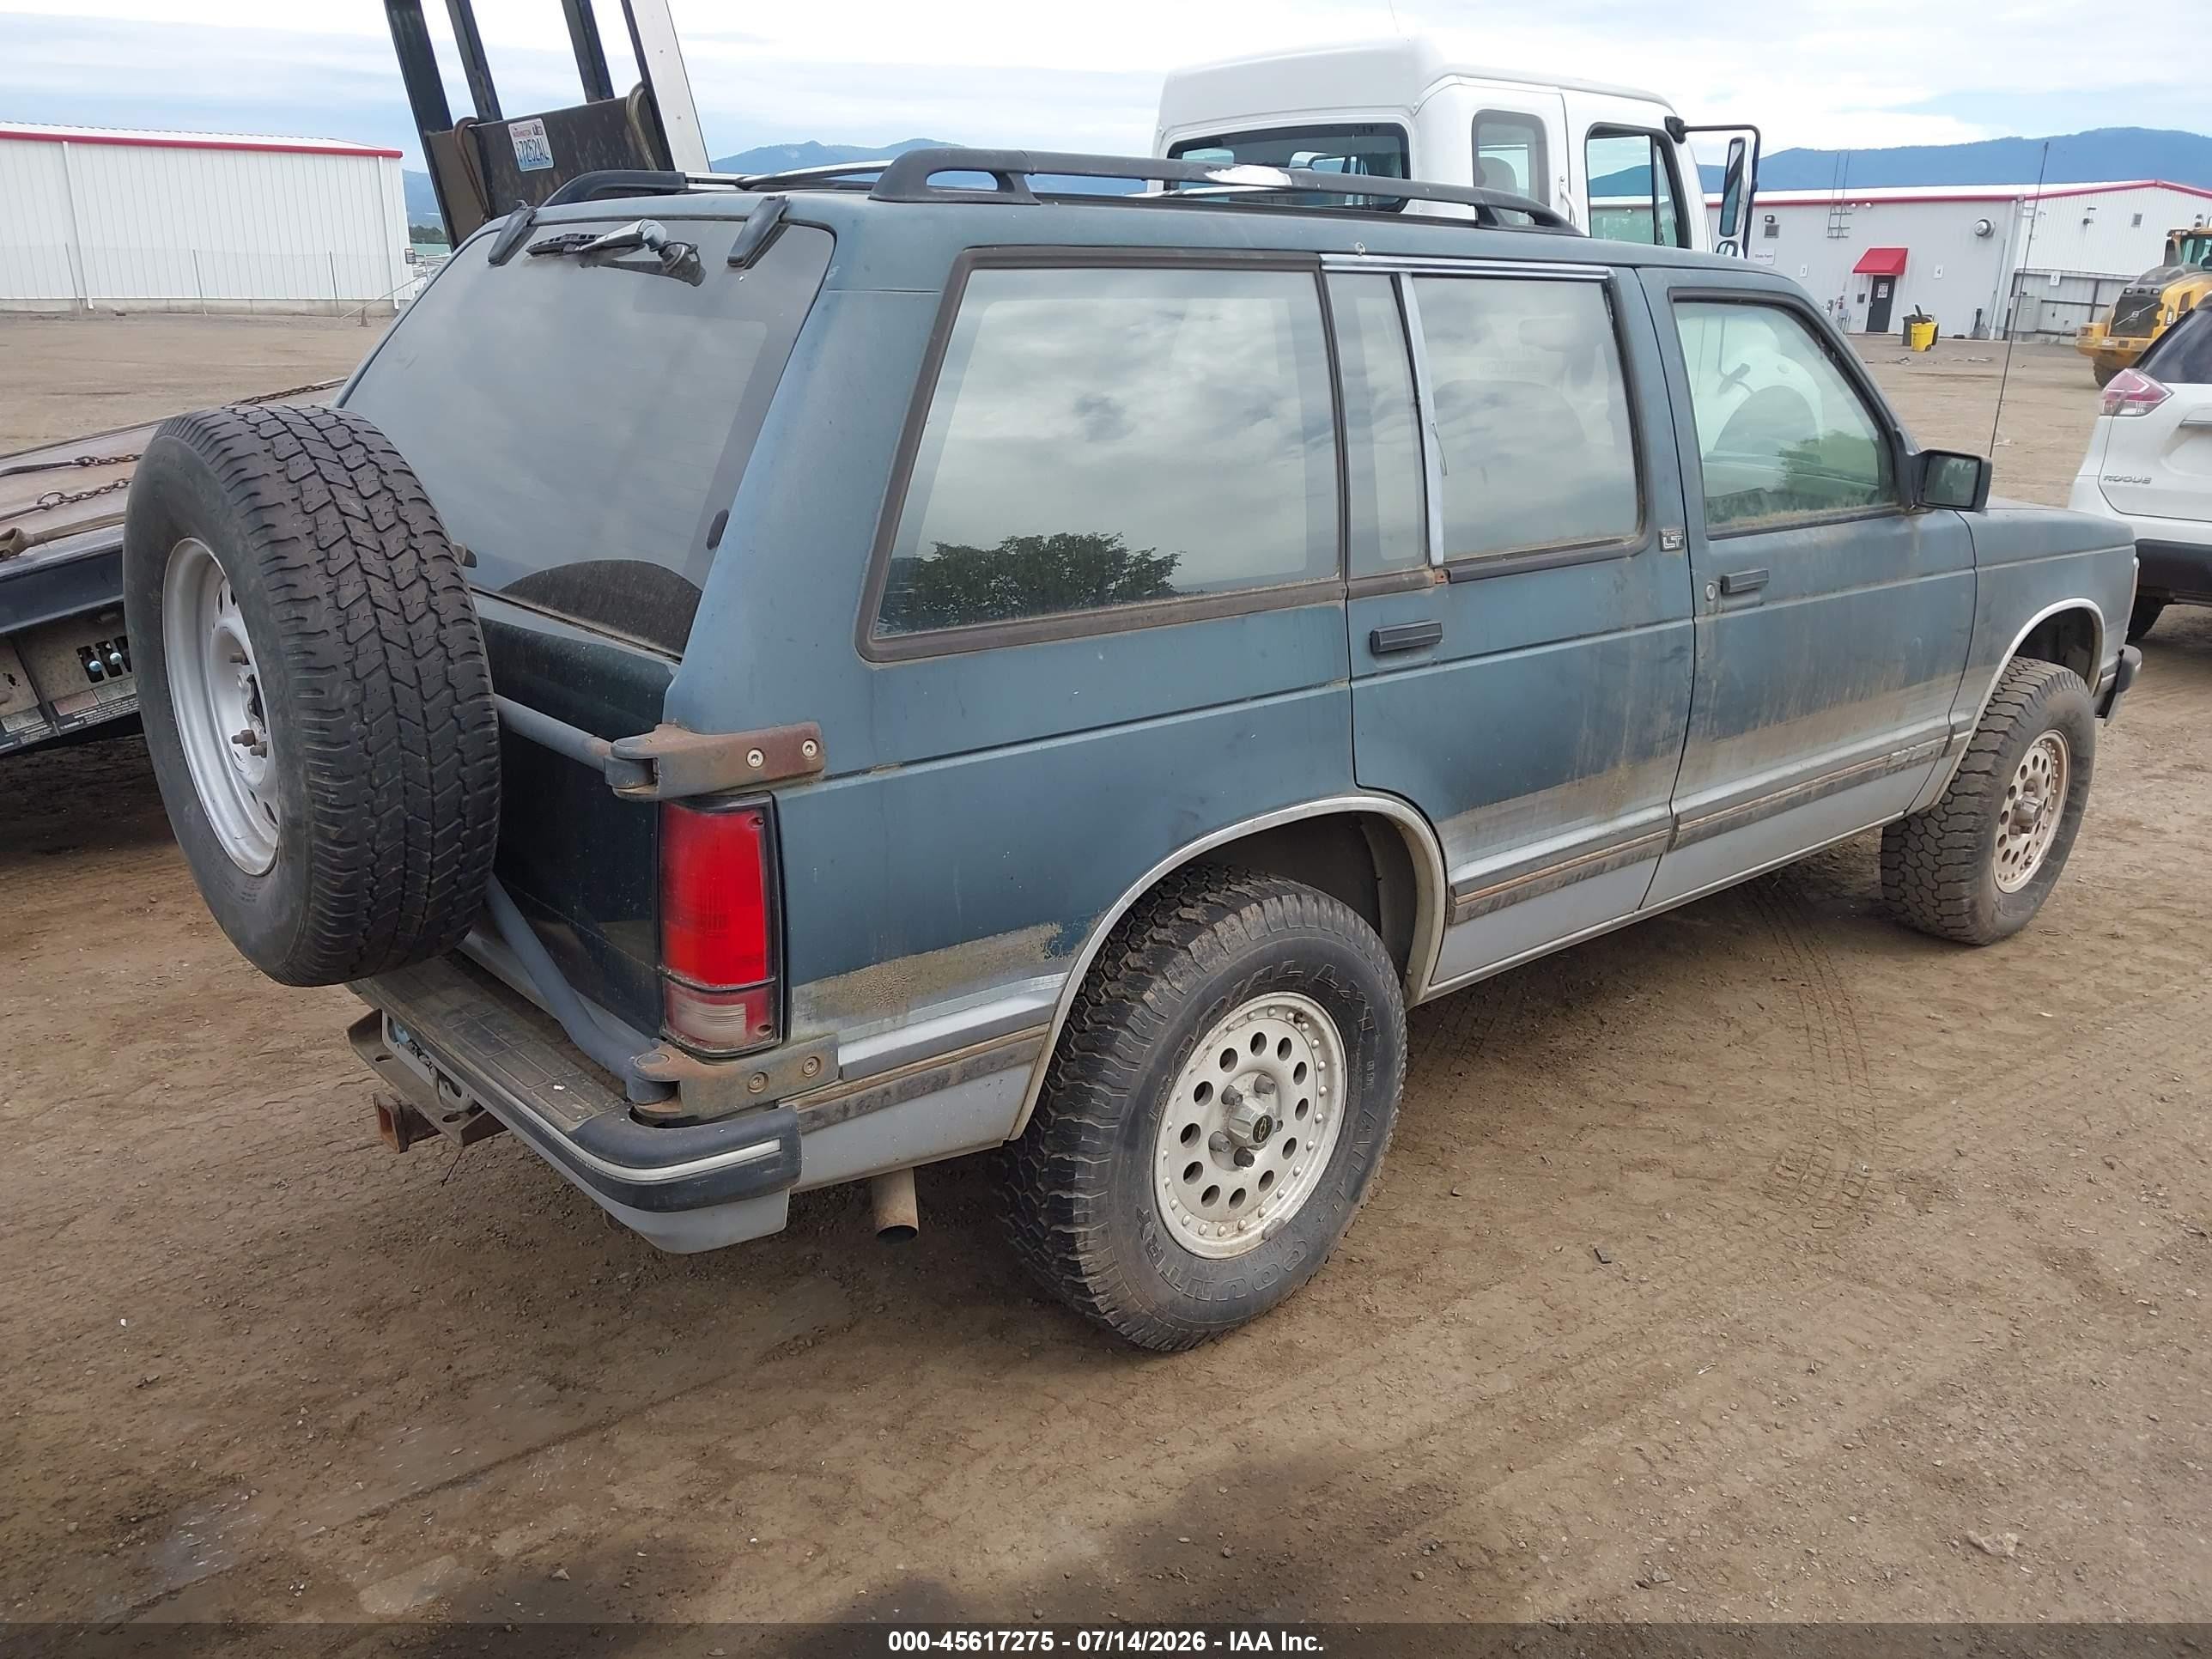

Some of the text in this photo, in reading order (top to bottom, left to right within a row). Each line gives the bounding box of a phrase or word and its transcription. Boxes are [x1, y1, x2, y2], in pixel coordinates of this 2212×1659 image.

[2103, 475, 2152, 485] ROGUE
[1662, 535, 1683, 549] LT
[1135, 1203, 1310, 1300] COUNTRY
